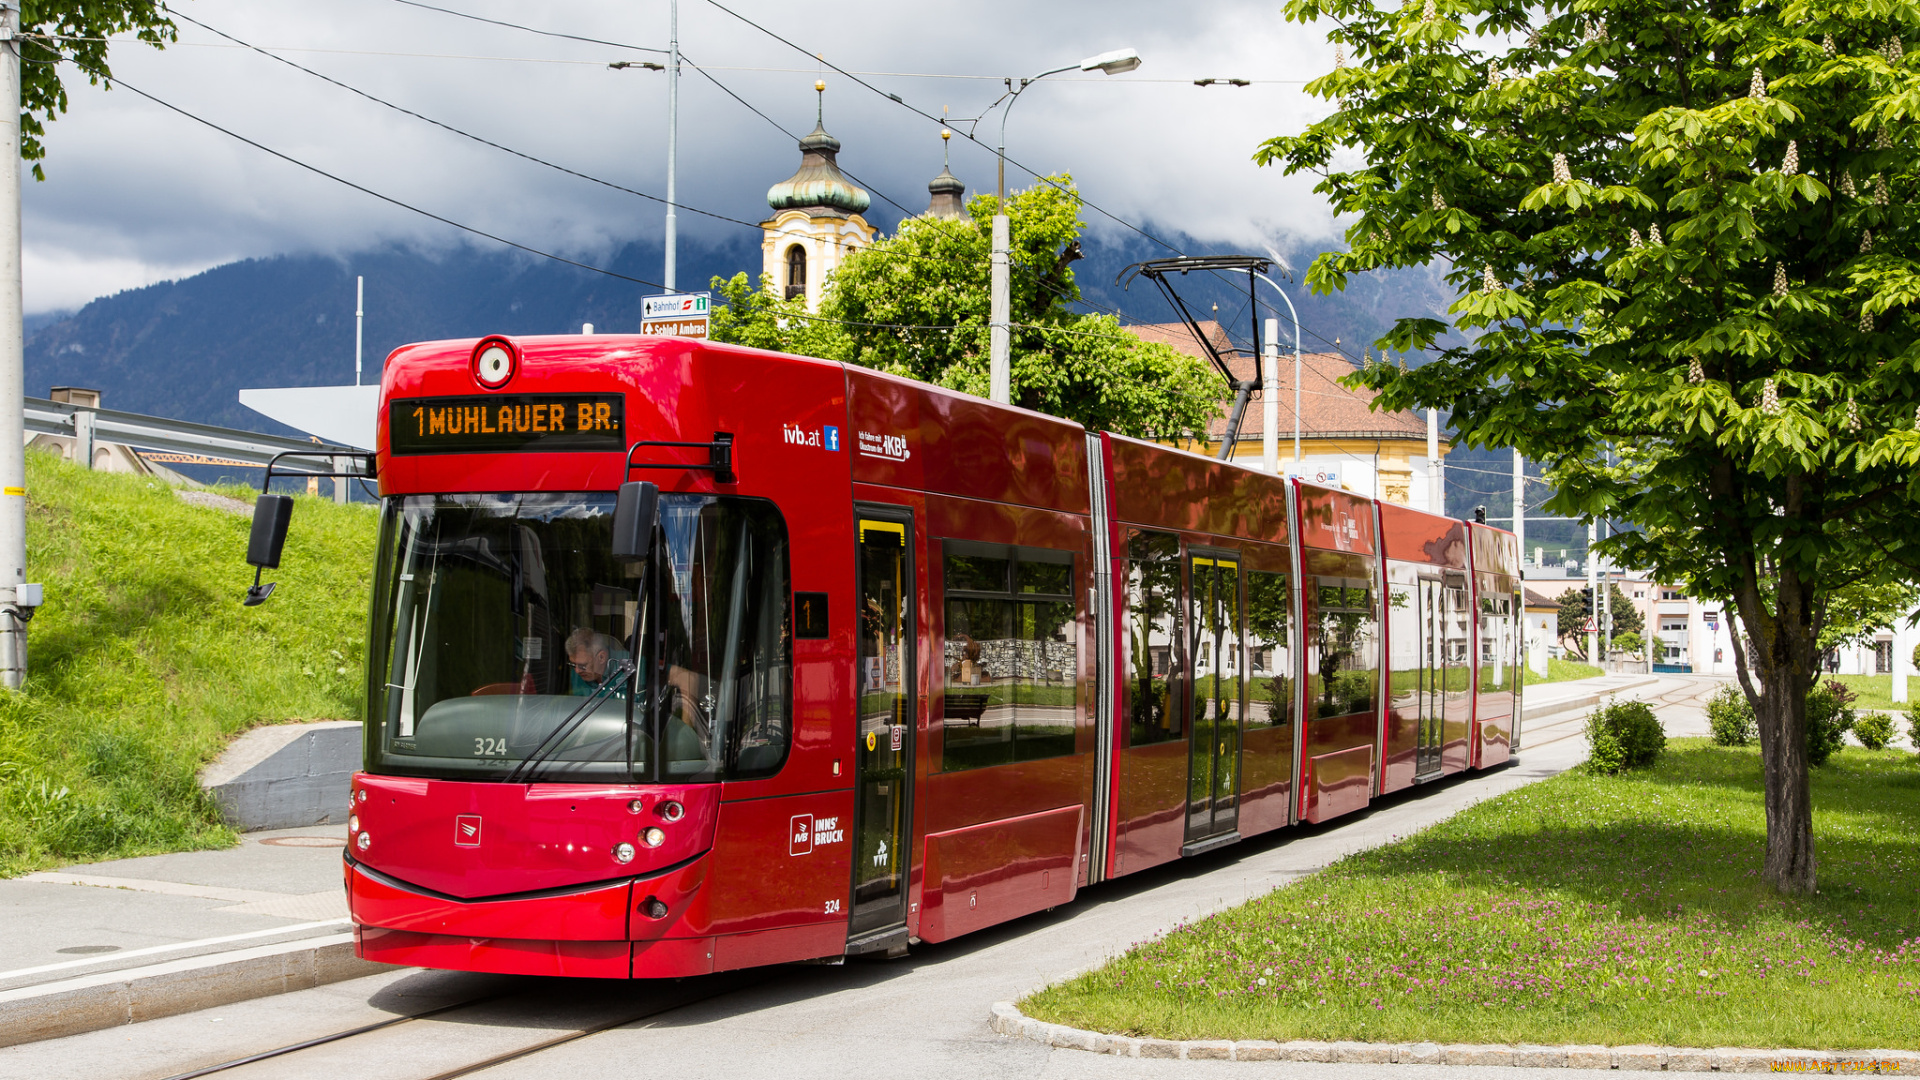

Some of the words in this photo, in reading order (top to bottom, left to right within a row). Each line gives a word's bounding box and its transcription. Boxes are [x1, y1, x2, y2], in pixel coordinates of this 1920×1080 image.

[653, 300, 679, 312] Bahnhof
[654, 323, 678, 336] Schloß
[679, 322, 705, 335] Ambras
[412, 406, 424, 437] 1
[429, 403, 565, 435] MÜHLAUER
[577, 402, 619, 431] BR.
[783, 423, 821, 447] ivb.at
[803, 600, 811, 630] 1
[473, 737, 507, 756] 324
[814, 829, 844, 846] BRUCK
[824, 899, 840, 915] 324
